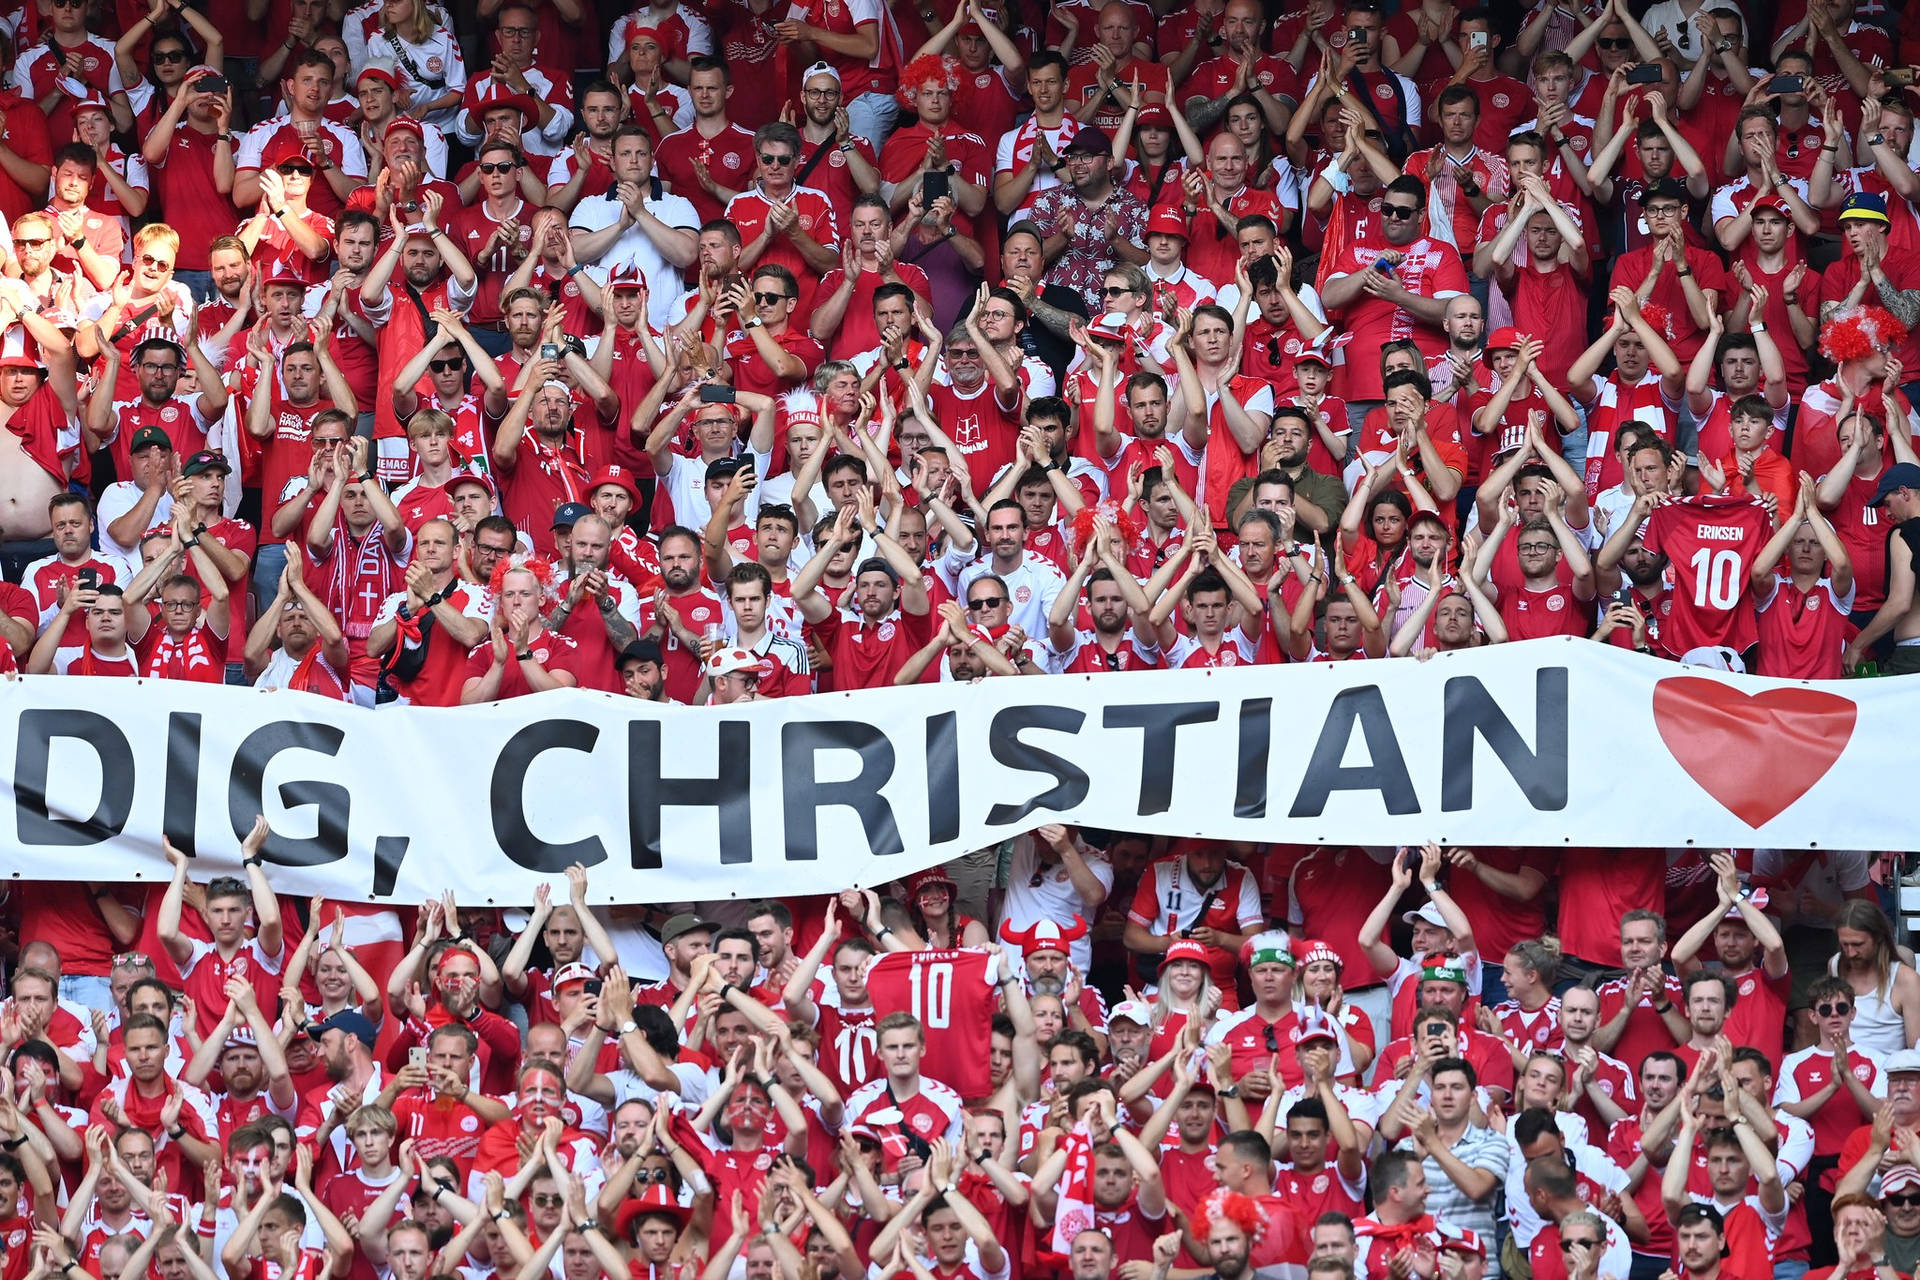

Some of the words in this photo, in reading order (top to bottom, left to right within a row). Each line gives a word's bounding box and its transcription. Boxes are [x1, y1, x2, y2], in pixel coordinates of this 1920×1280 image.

[1551, 155, 1562, 180] 4
[491, 245, 507, 273] 11
[1697, 524, 1744, 541] ERIKSEN
[1690, 547, 1742, 611] 10
[13, 708, 411, 897] DIG,
[490, 666, 1569, 874] CHRISTIAN
[1167, 890, 1183, 912] 11
[908, 962, 954, 1030] 10
[411, 1111, 425, 1137] 11
